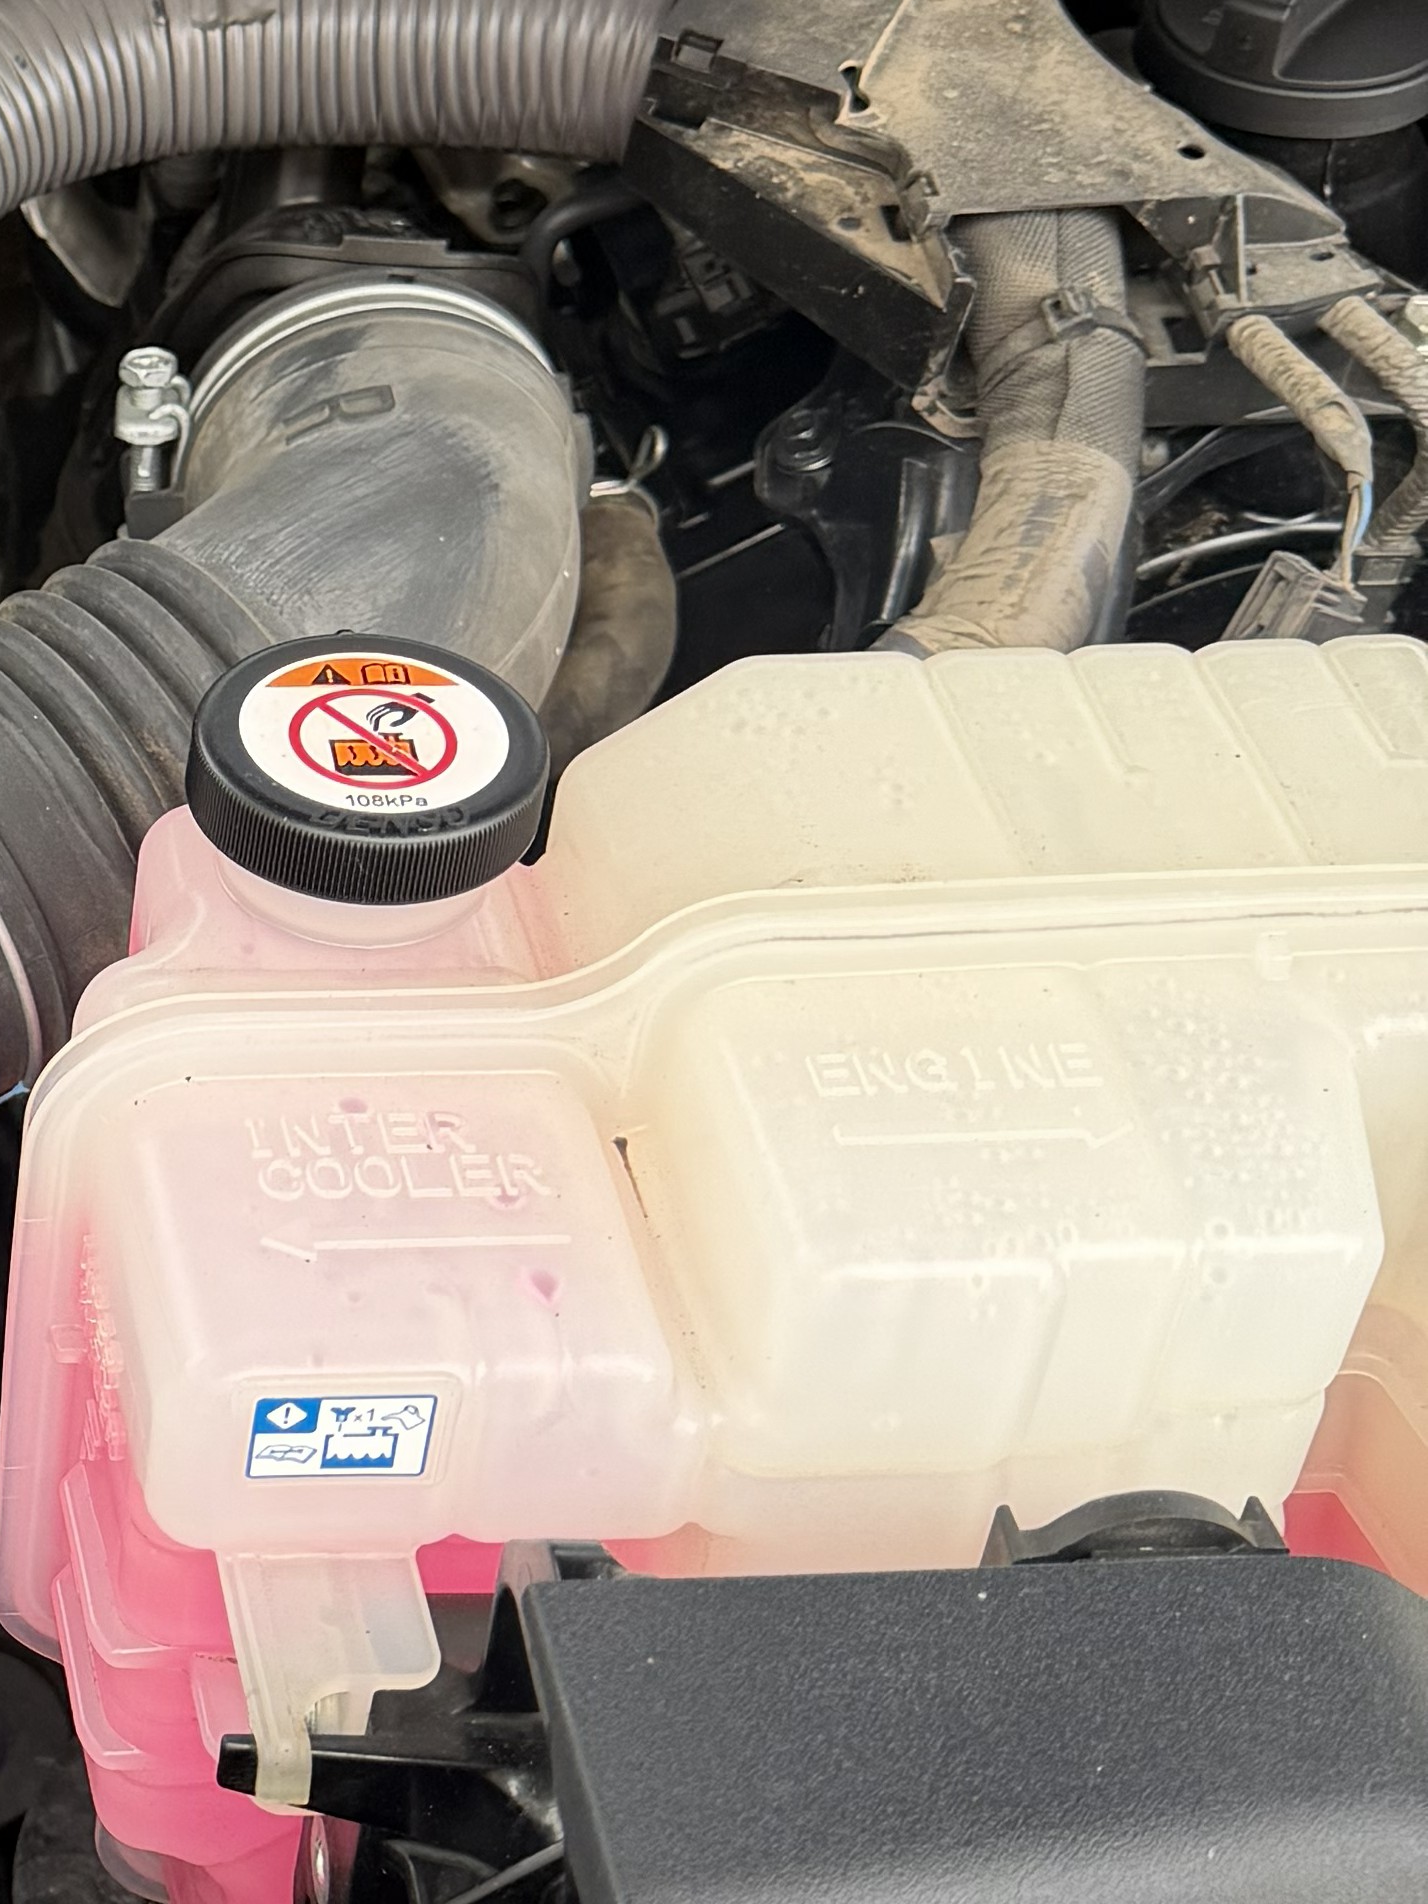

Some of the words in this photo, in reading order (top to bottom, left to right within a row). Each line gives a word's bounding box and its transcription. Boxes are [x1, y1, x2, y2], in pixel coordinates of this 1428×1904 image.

[309, 805, 472, 837] DENSO
[345, 794, 429, 807] 108kPa
[805, 1043, 1104, 1096] ENGINE
[245, 1111, 477, 1159] INTER
[258, 1154, 551, 1201] COOLER
